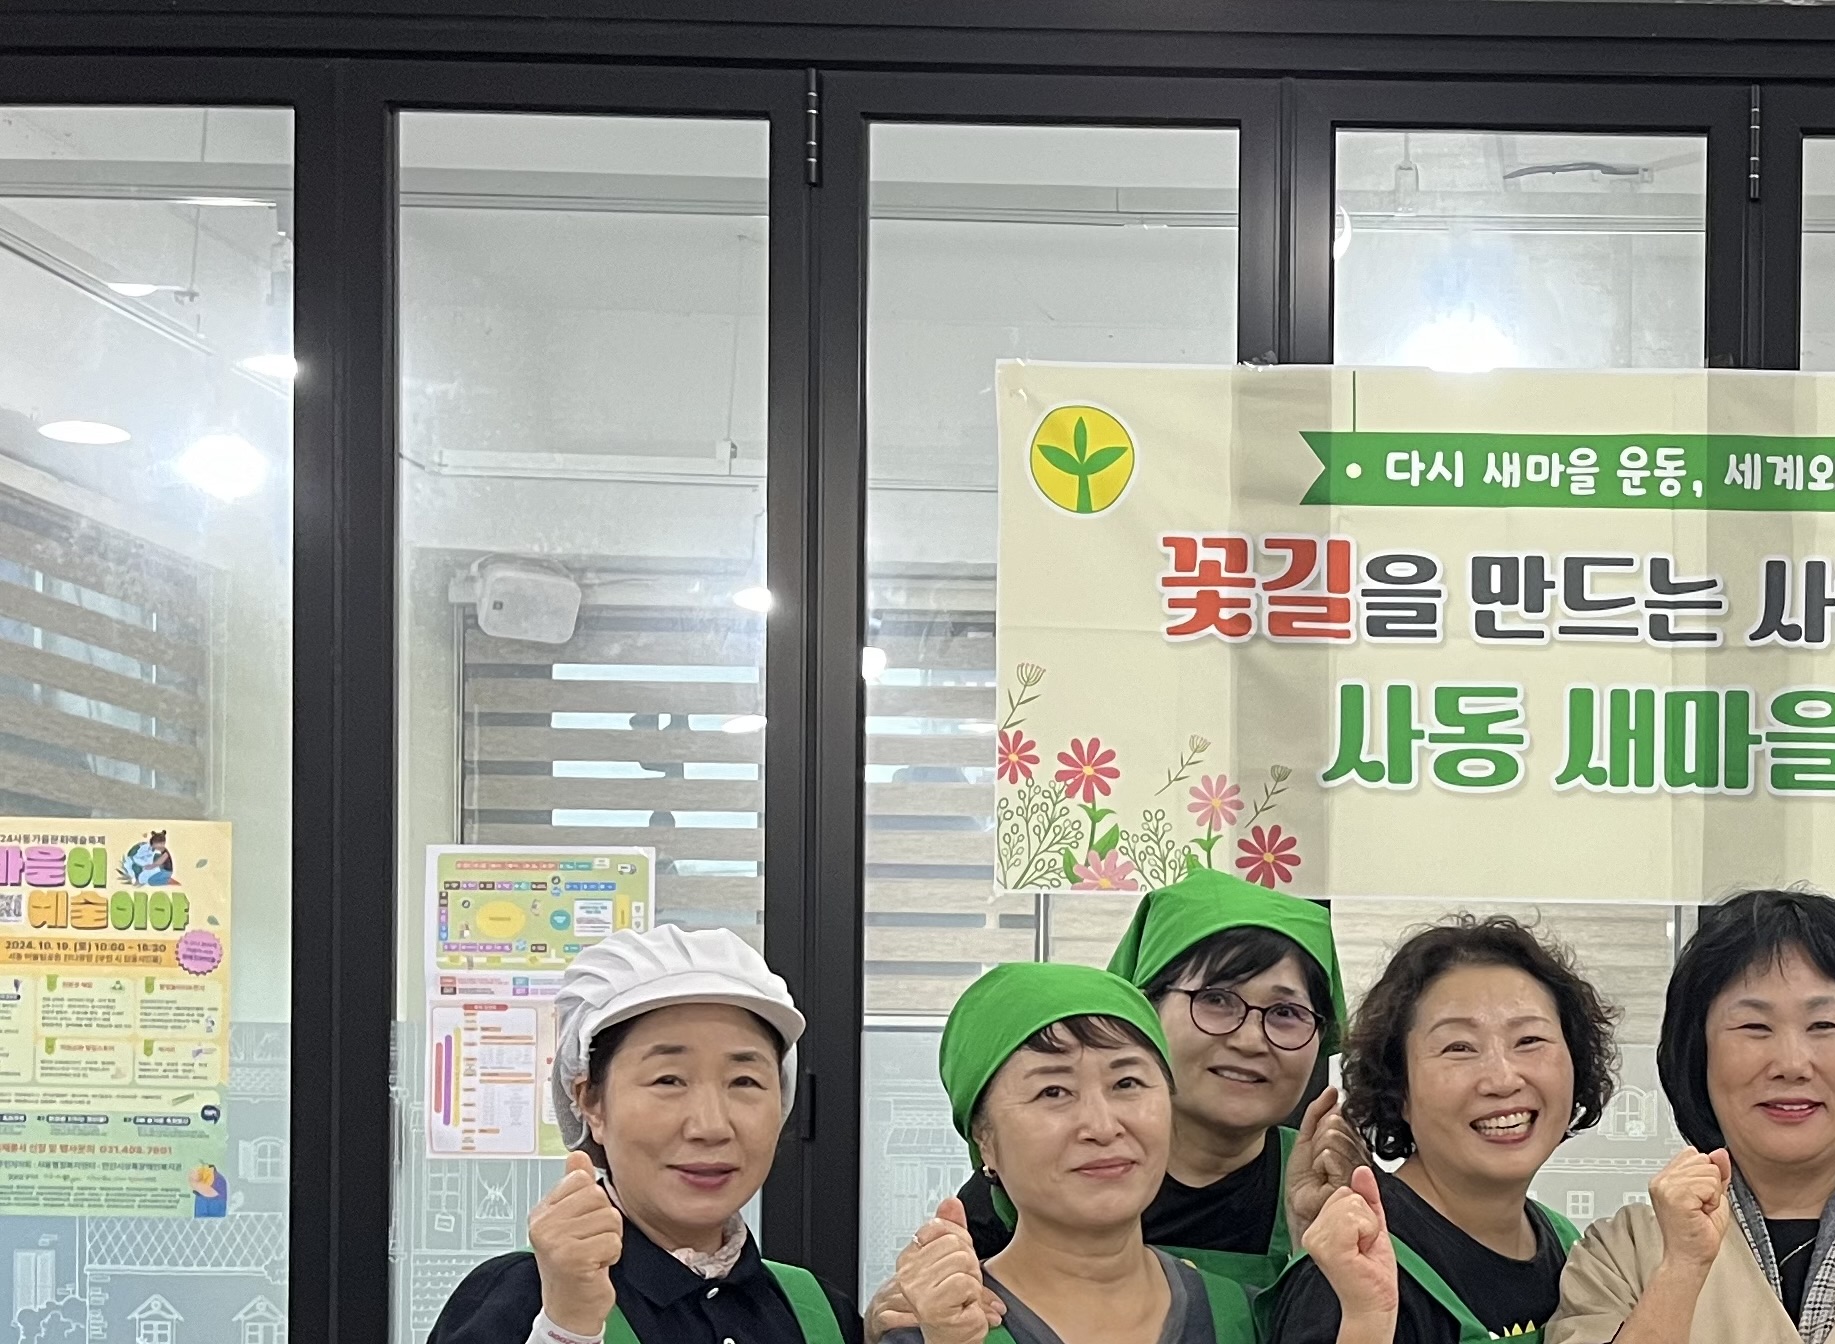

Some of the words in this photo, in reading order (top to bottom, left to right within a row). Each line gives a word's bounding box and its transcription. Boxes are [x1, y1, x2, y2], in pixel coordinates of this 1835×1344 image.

[1385, 449, 1464, 488] 다시
[1482, 447, 1600, 496] 새마을
[1616, 446, 1703, 498] 운동,
[1163, 537, 1441, 640] 꽃길을
[1471, 555, 1723, 642] 만드는
[1327, 686, 1523, 787] 사동
[28, 890, 191, 931] 예술이야
